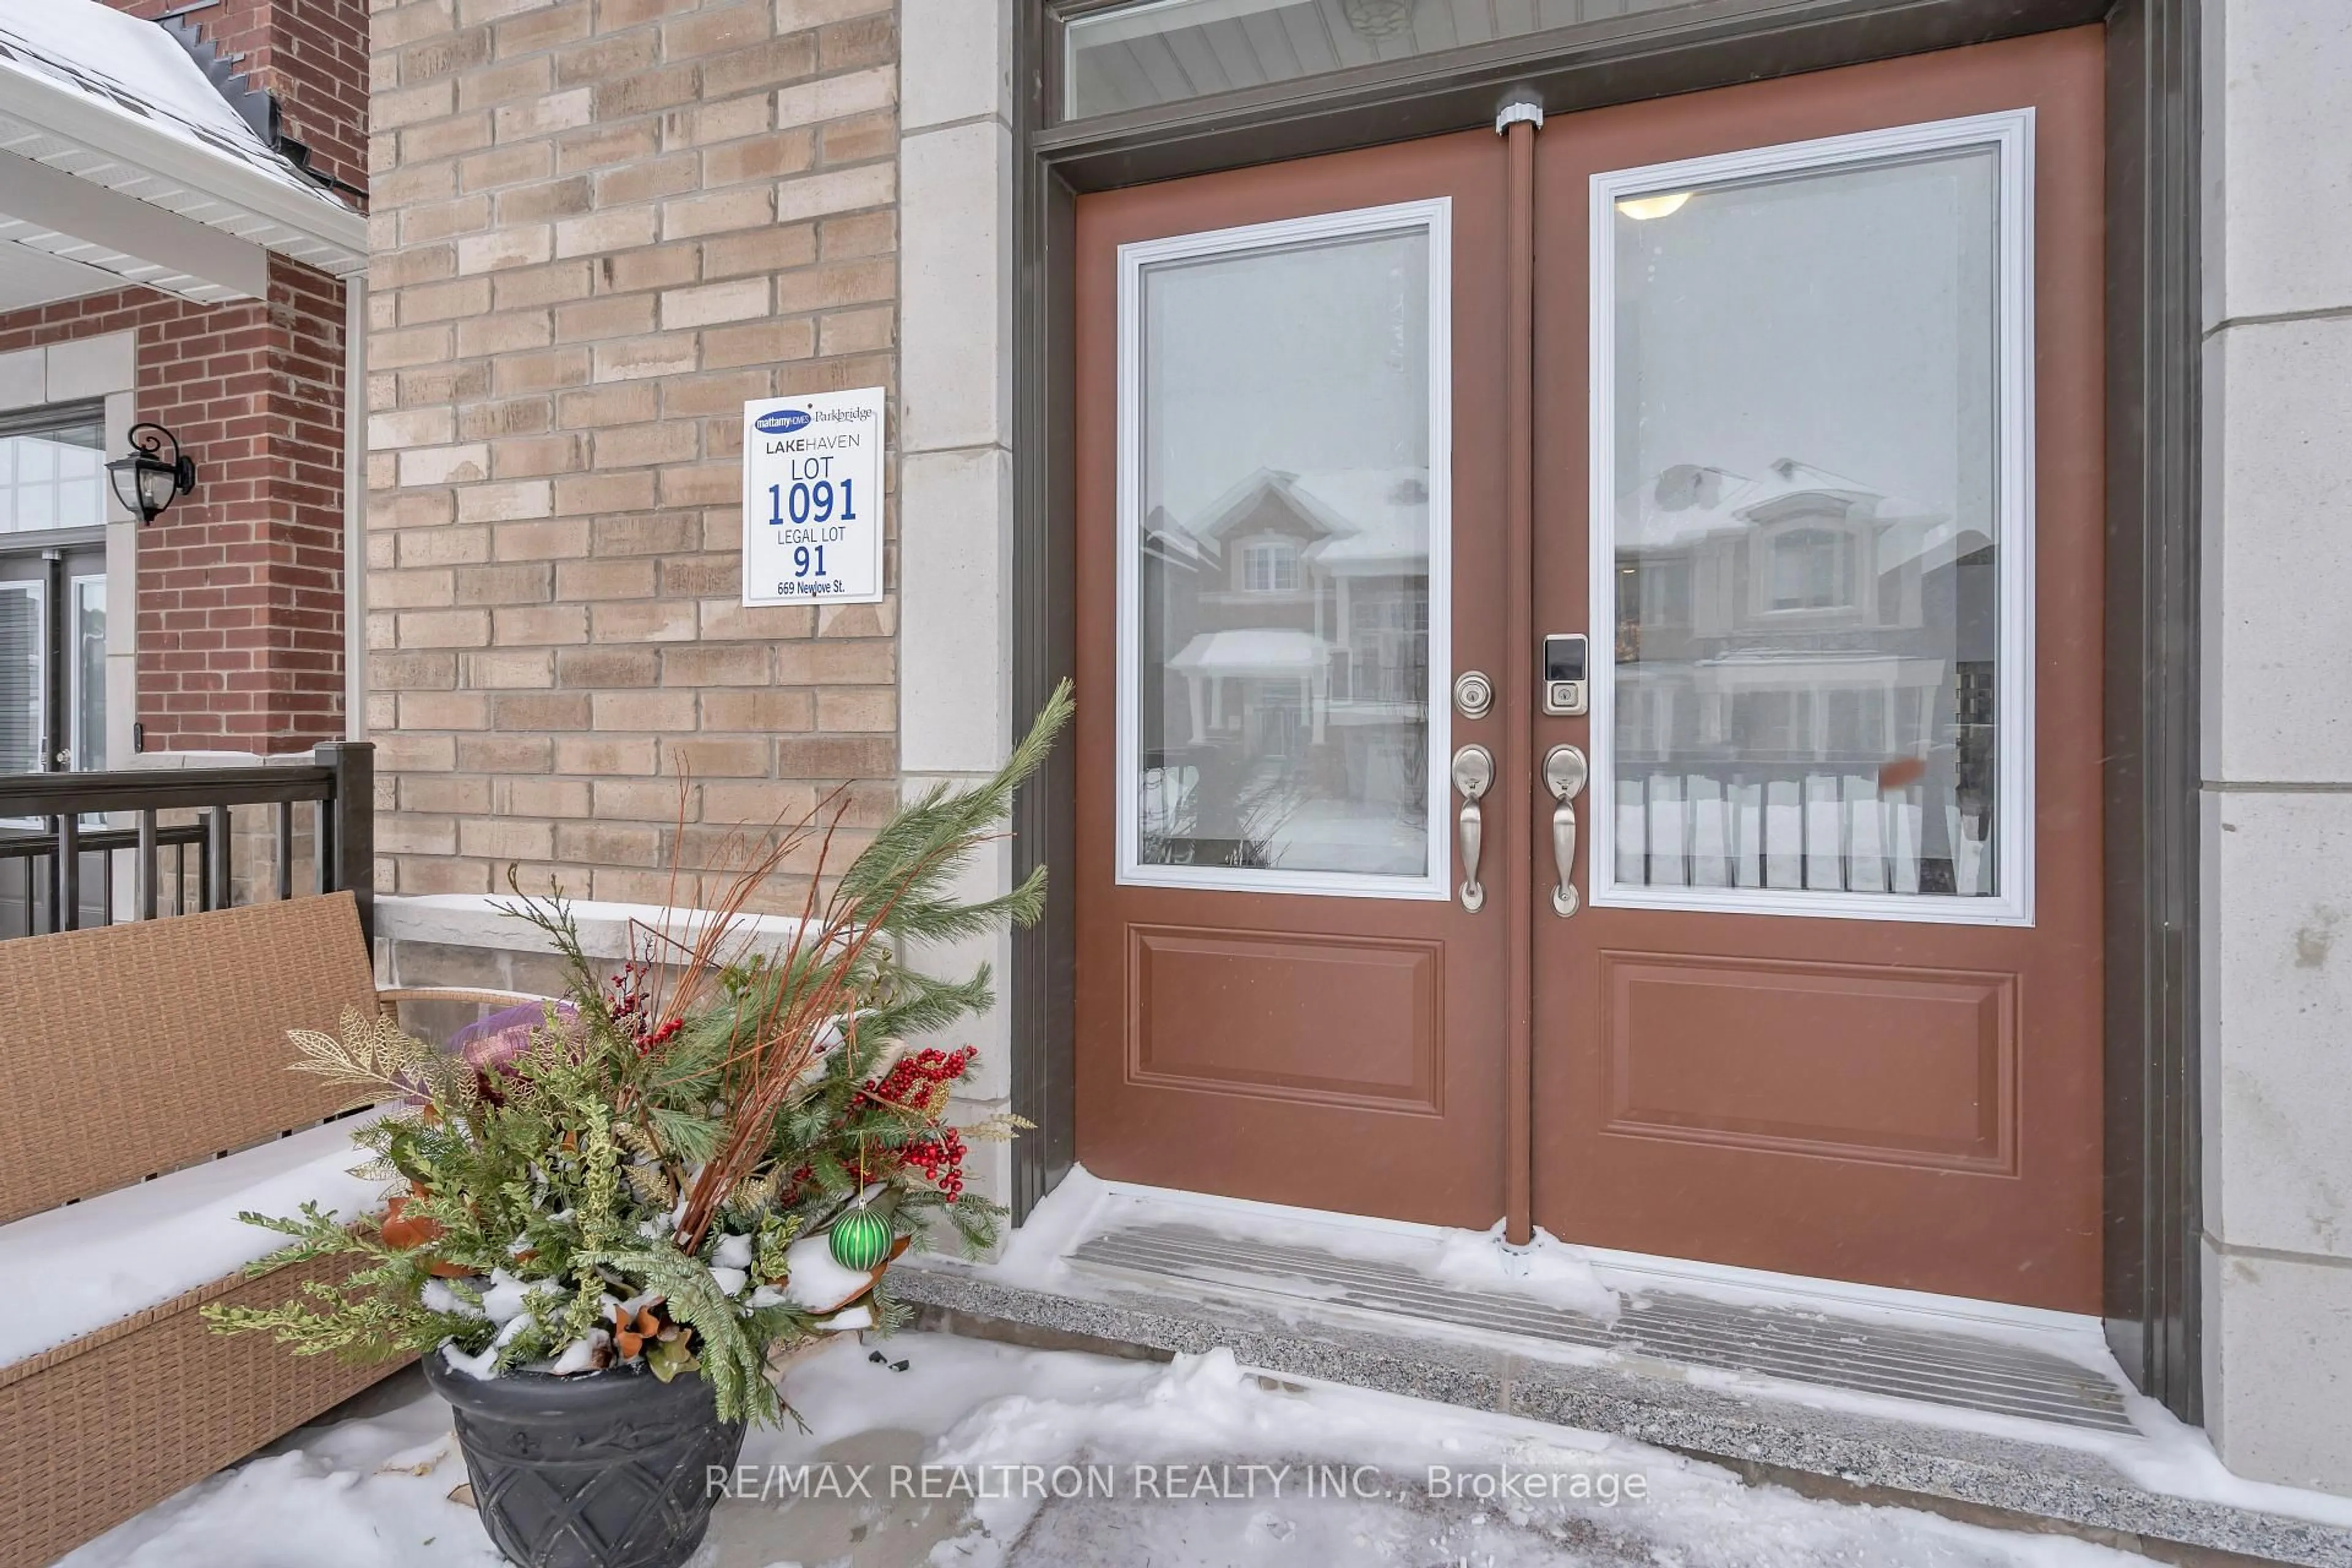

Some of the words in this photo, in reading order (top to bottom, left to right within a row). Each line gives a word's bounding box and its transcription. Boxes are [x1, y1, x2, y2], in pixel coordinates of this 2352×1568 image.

[815, 407, 872, 423] Parkbridge
[766, 434, 860, 454] LAKEHAVEN
[792, 456, 834, 480] LOT
[769, 478, 856, 525] 1091
[778, 529, 818, 545] LEGAL
[822, 527, 846, 542] LOT
[794, 545, 826, 577] 91
[777, 582, 794, 595] 669
[797, 581, 831, 594] Newlove
[833, 579, 845, 592] St.
